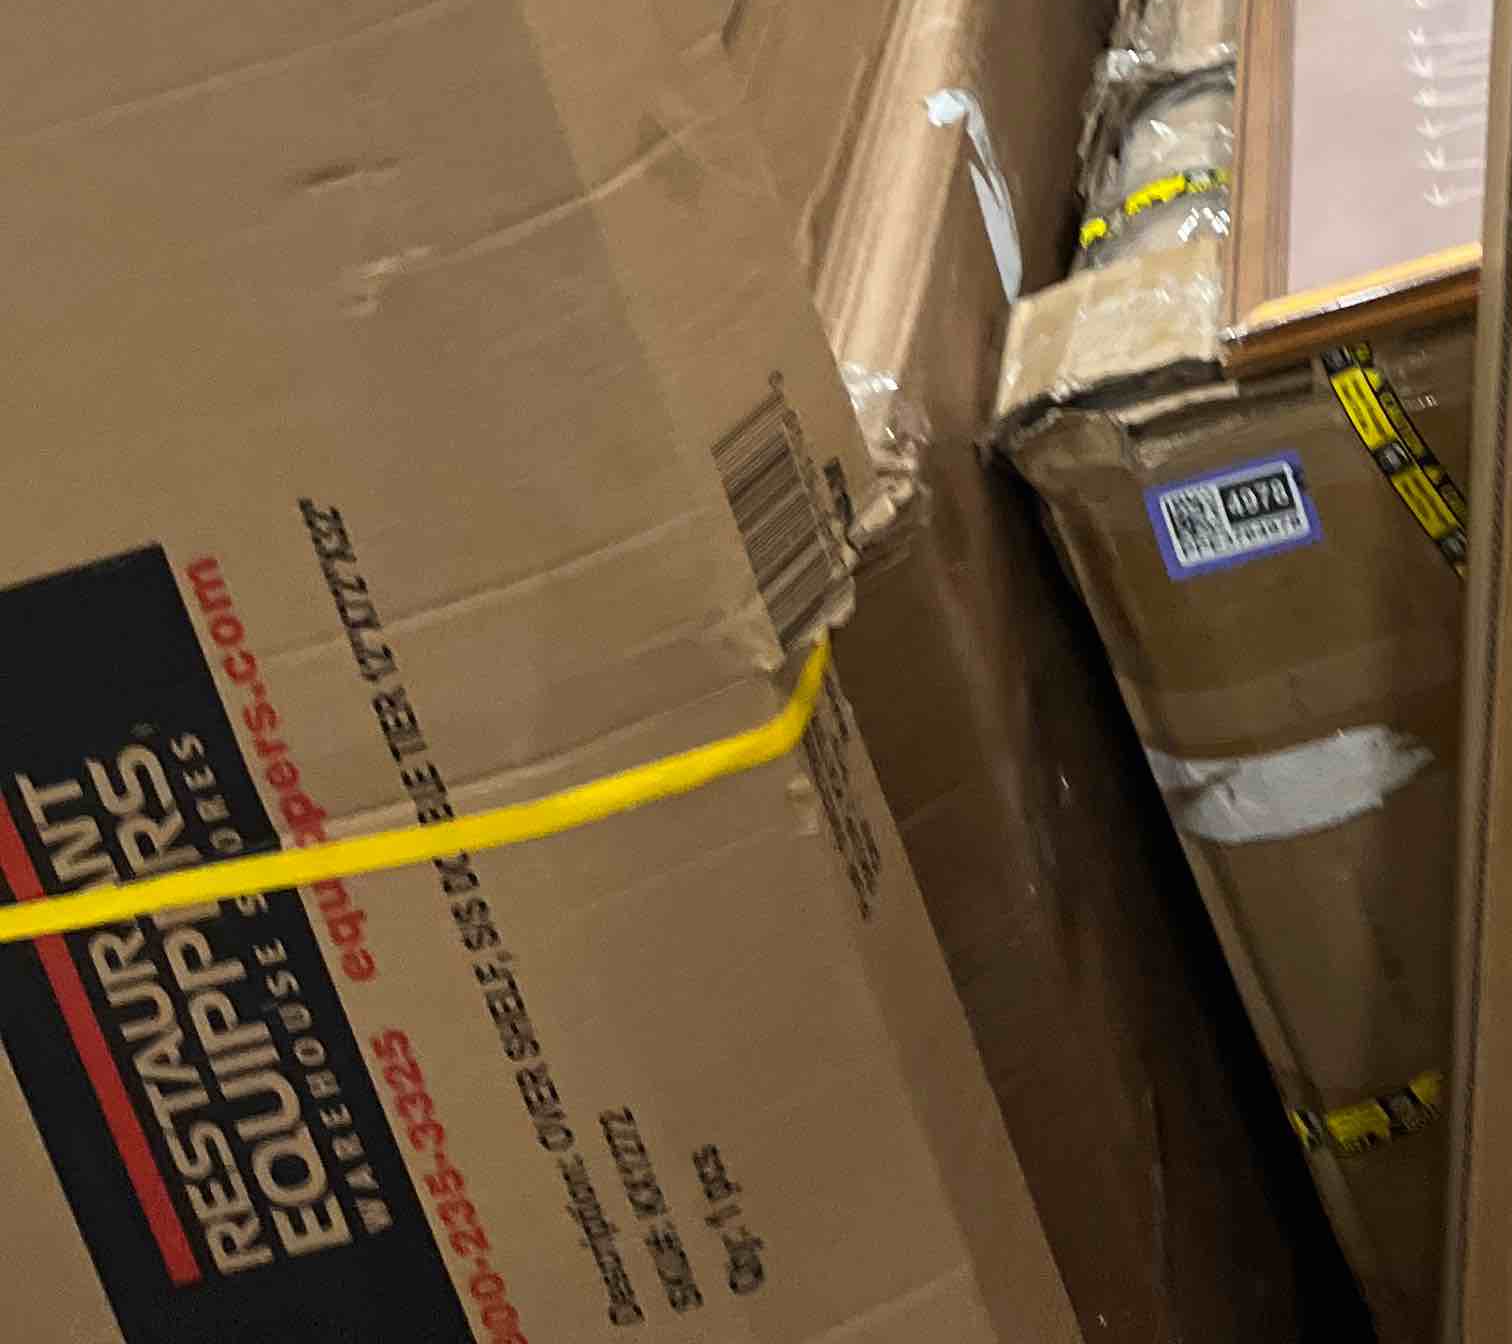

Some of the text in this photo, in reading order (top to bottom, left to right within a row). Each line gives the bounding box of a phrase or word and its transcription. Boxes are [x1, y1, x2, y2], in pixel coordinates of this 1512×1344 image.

[11, 771, 276, 1272] RESTAURNT
[163, 724, 402, 1239] WAREHOUSE SORES
